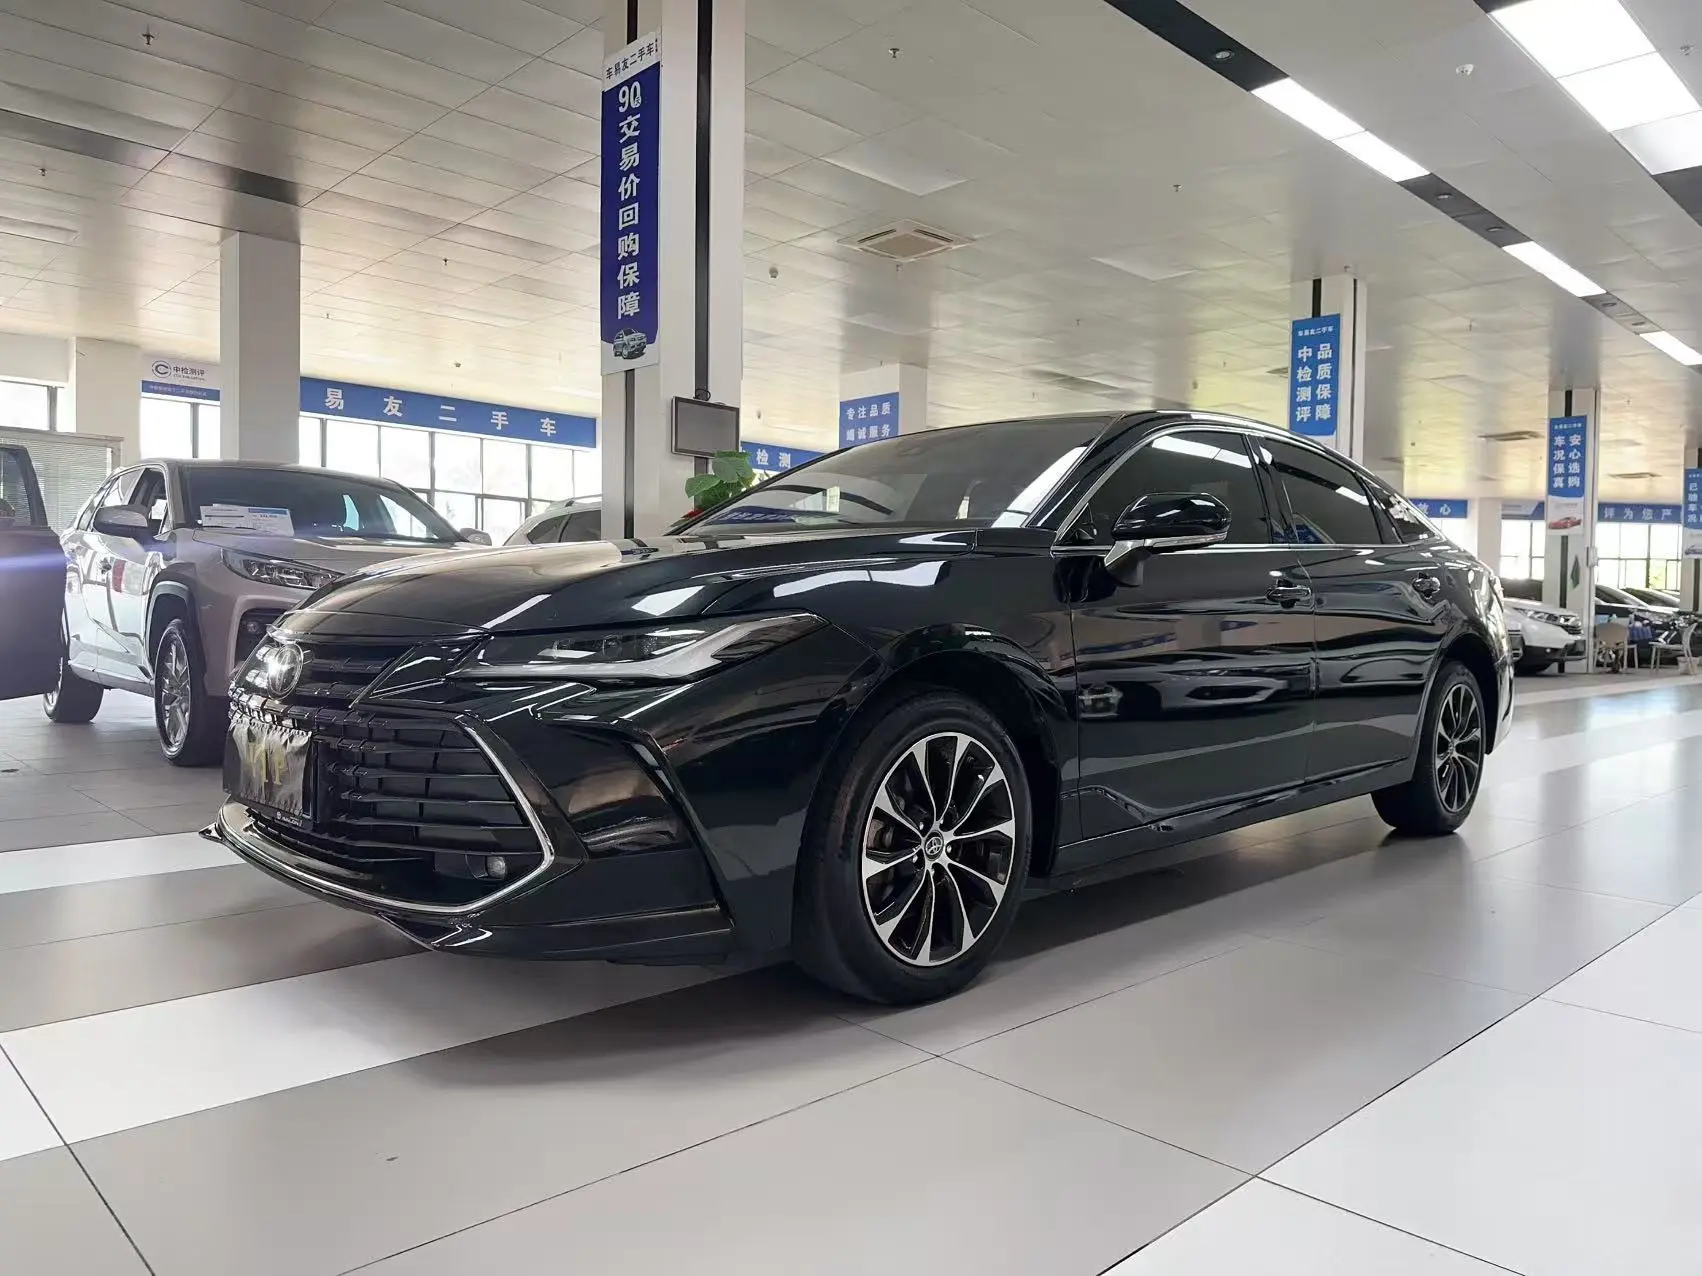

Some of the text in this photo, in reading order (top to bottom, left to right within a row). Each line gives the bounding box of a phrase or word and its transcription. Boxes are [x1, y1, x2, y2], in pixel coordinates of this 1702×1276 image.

[1296, 345, 1313, 422] 中检测评
[1315, 343, 1333, 421] 品质保障
[324, 387, 557, 437] 易友二手车
[846, 402, 891, 420] 专注品质
[740, 446, 792, 470] 检测
